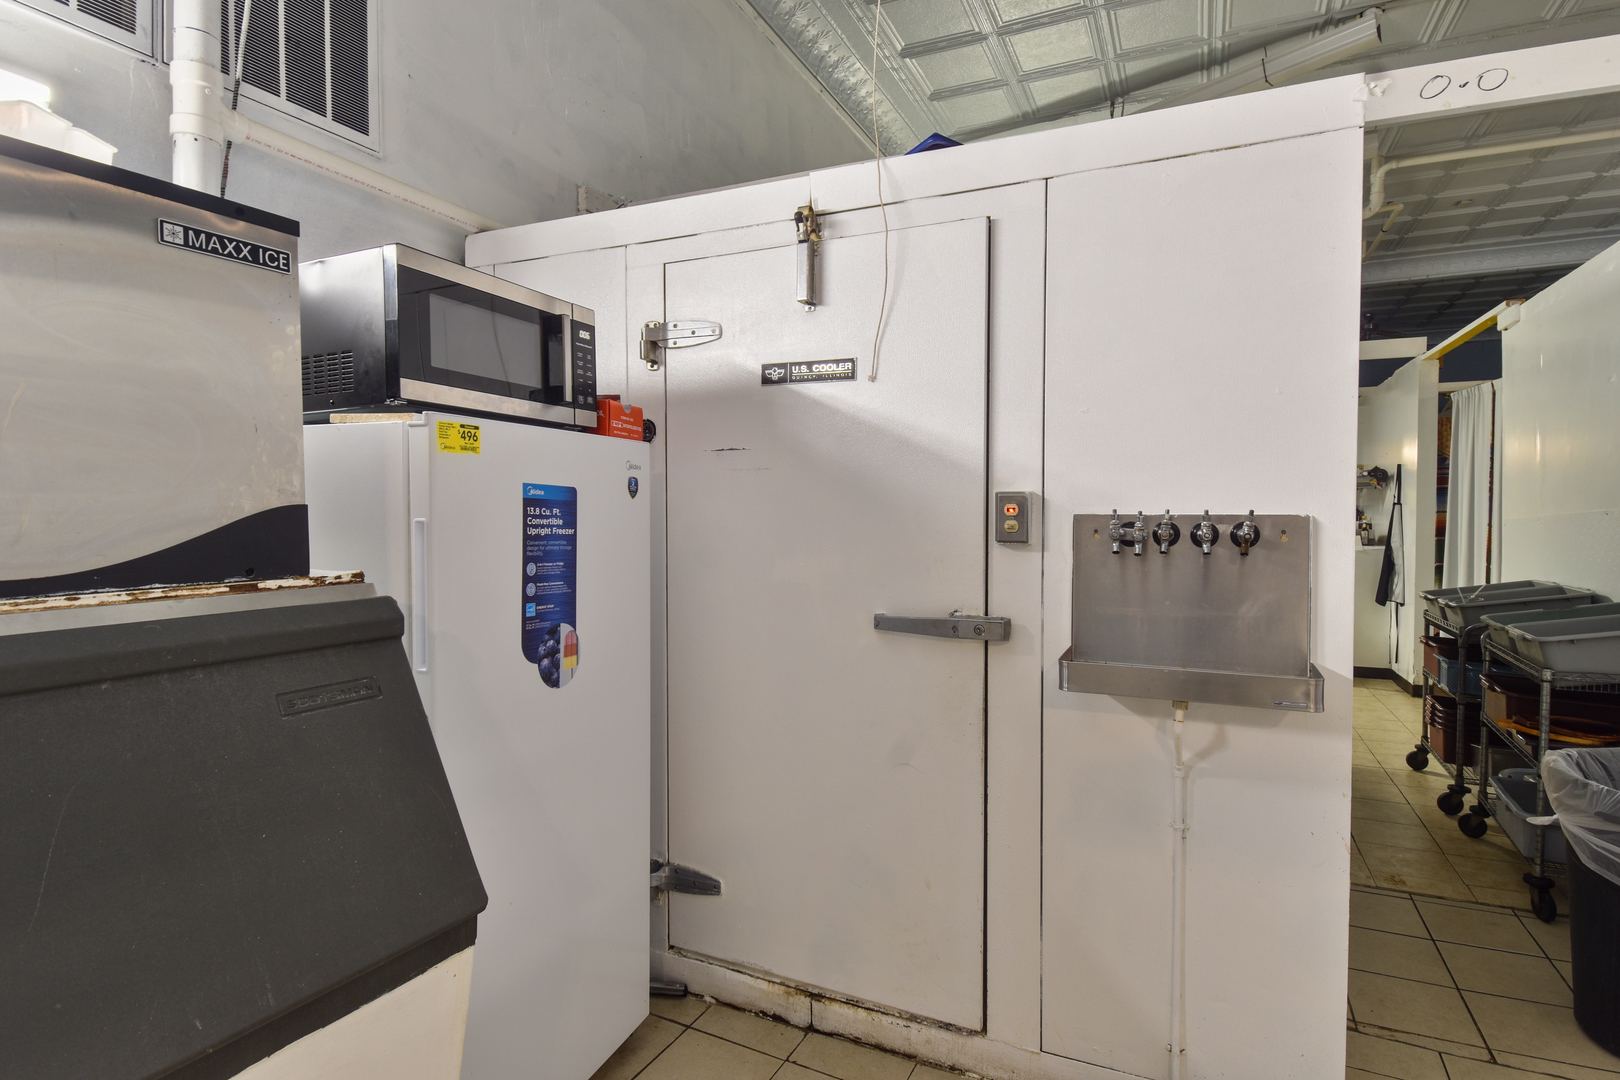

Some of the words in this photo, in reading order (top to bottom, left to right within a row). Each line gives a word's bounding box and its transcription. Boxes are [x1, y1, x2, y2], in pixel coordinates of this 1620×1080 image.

[188, 230, 252, 261] MAXX
[259, 248, 288, 270] ICE
[792, 365, 810, 373] U.S.
[812, 362, 852, 372] COOLER
[457, 429, 479, 442] $496
[527, 486, 544, 495] Midea
[527, 507, 540, 515] 13.8
[552, 508, 562, 516] Ft.
[527, 517, 564, 525] Convertible
[527, 527, 551, 536] Upright
[552, 527, 575, 535] Freezer
[286, 684, 375, 709] SCOTSMAN
